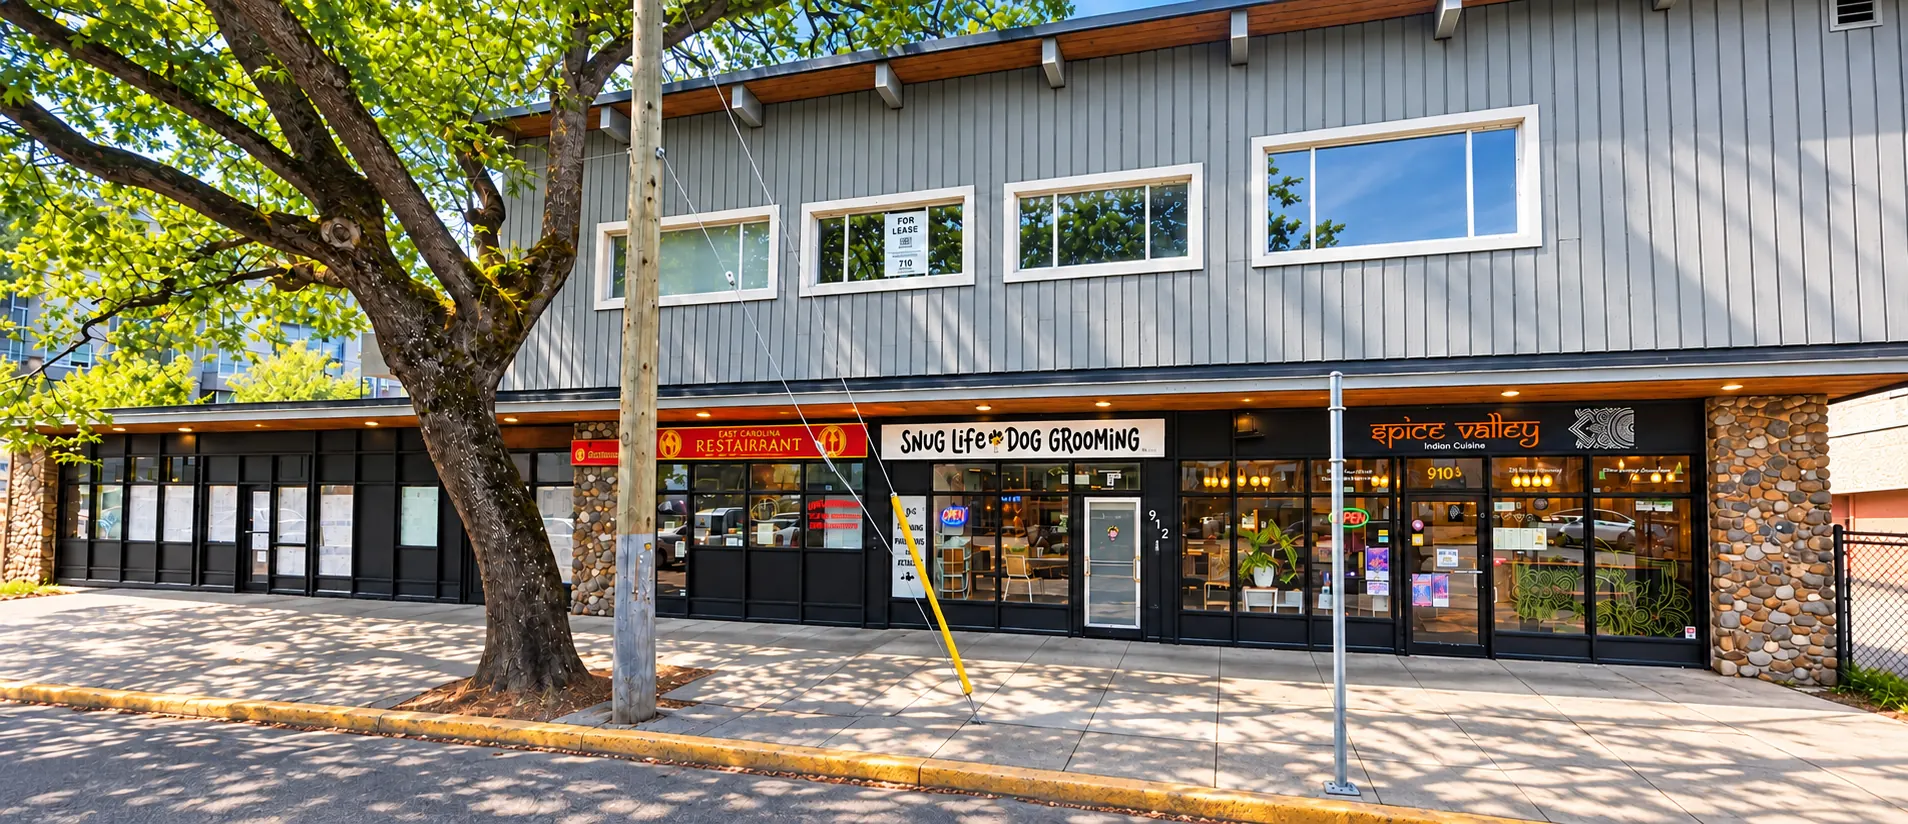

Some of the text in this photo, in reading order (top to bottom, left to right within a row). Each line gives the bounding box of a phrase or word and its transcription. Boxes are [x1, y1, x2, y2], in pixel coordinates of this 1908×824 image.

[898, 216, 914, 225] FOR
[892, 226, 918, 234] LEASE
[899, 259, 912, 267] 710
[718, 430, 738, 438] EAST
[1370, 412, 1541, 449] spice valley
[900, 429, 945, 454] SNUG
[1004, 426, 1042, 452] DOG
[1424, 441, 1486, 450] Indian Cuisine
[1427, 466, 1454, 480] 910
[1342, 511, 1366, 525] PEN
